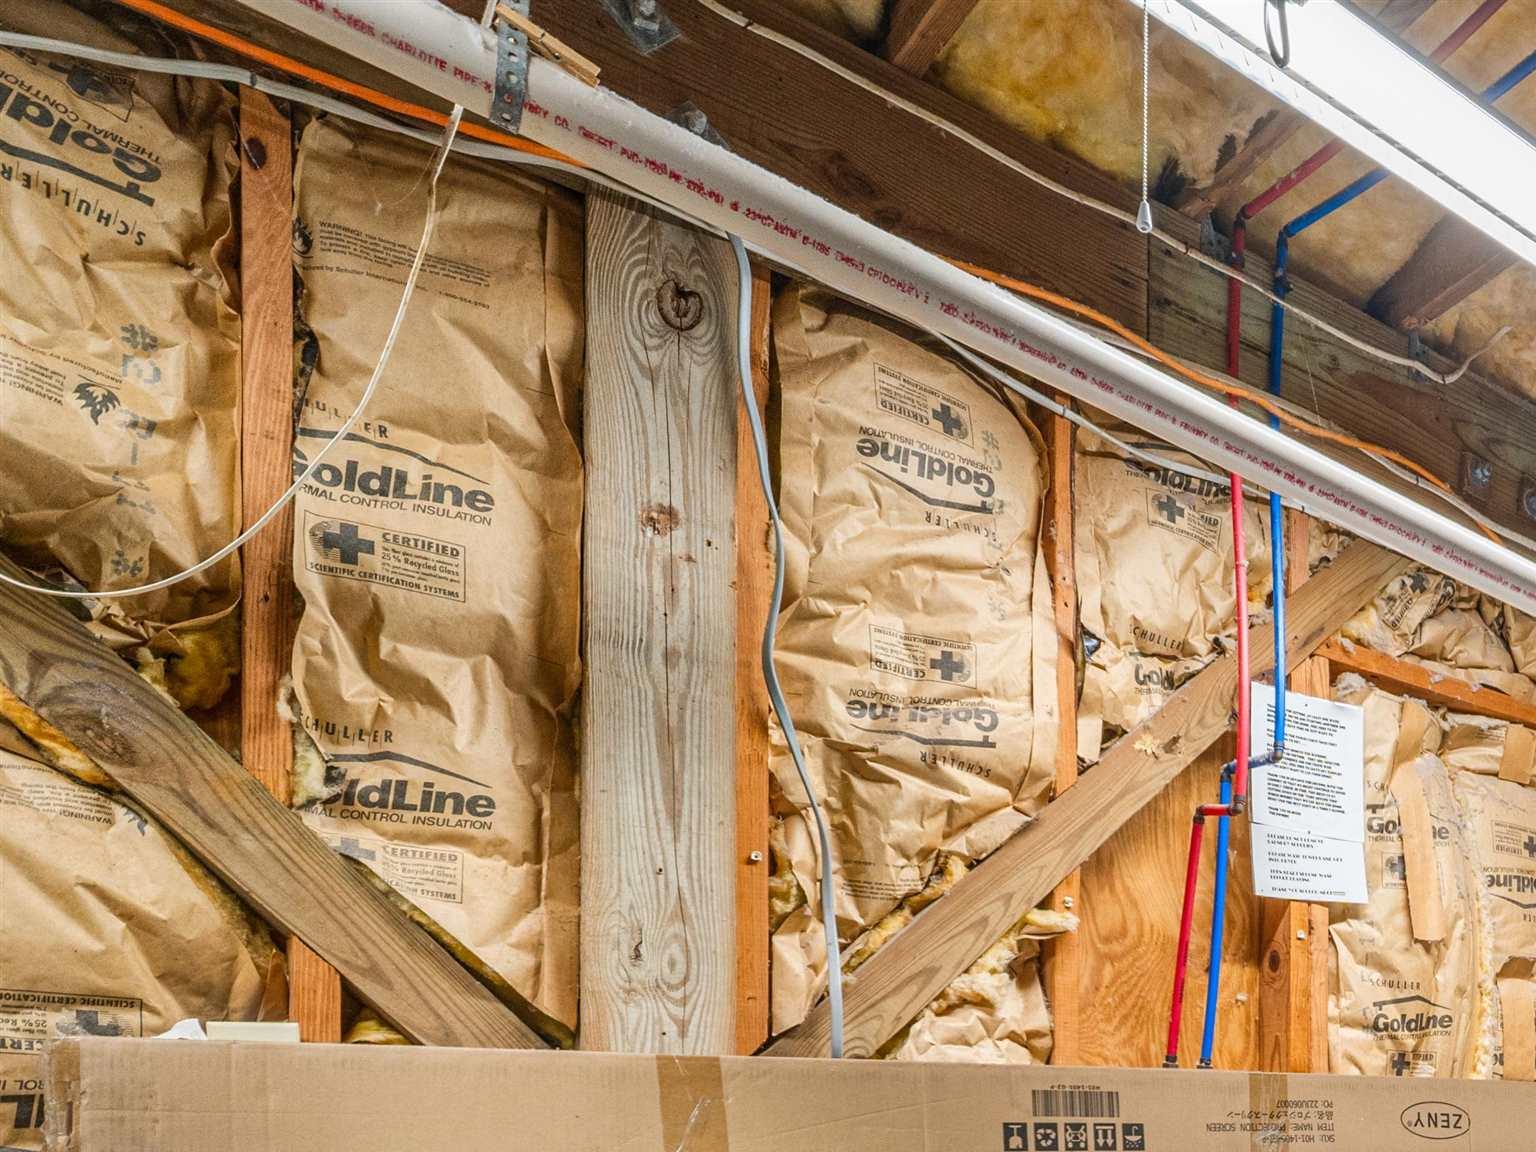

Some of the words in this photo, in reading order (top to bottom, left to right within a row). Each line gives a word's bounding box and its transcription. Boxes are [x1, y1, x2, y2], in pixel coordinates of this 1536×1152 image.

[856, 438, 996, 498] GoldLine
[340, 494, 408, 511] CONTROL
[412, 505, 492, 526] INSULATION
[382, 533, 460, 557] CERTIFIED
[309, 561, 355, 577] SCIENTIFIC
[358, 570, 420, 590] CERTIFICATION
[423, 584, 460, 598] SYSTEMS
[920, 751, 992, 778] SCHULLER
[340, 808, 407, 824] CONTROL
[412, 815, 493, 831] INSULATION
[80, 997, 136, 1008] SCIENTIFIC
[1206, 1122, 1236, 1132] SCREEN
[1240, 1122, 1286, 1132] PROJECTION
